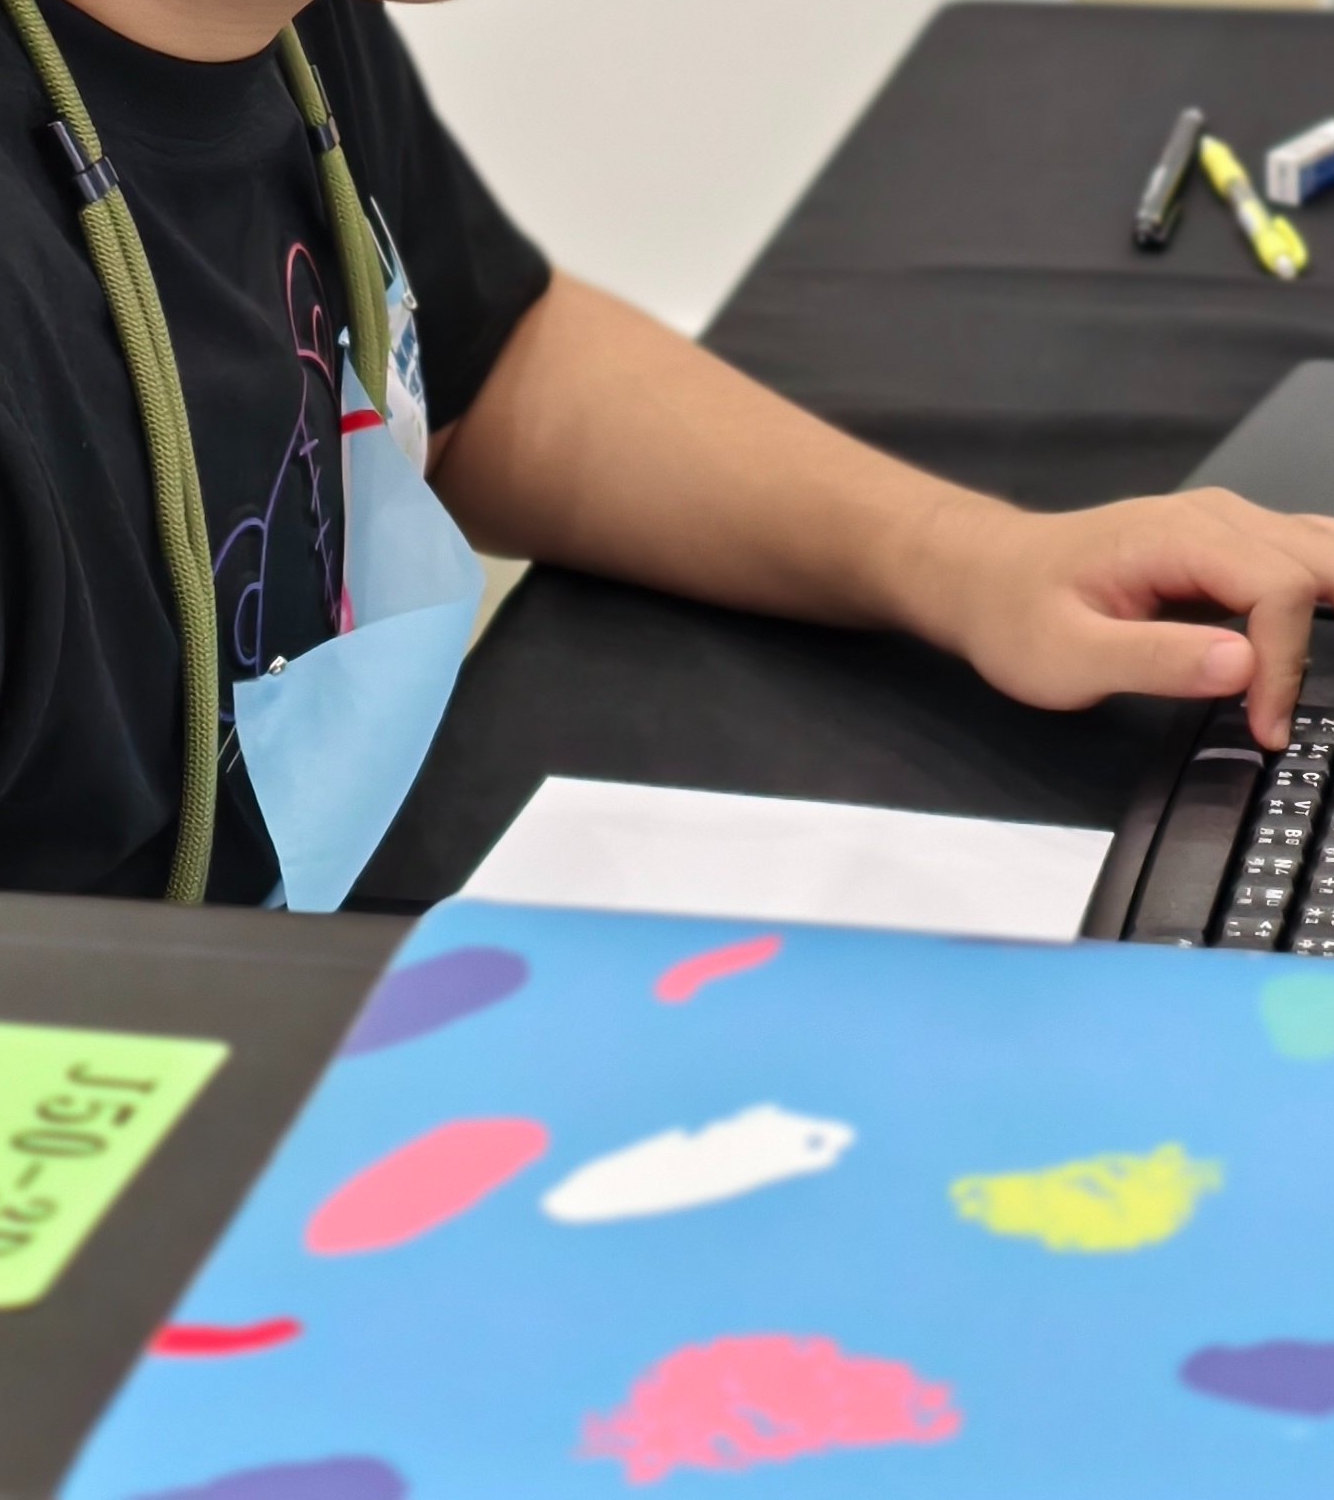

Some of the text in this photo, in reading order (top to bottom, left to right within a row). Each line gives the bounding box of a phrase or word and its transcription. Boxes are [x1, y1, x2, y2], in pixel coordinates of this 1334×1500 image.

[1312, 744, 1329, 752] X
[1303, 772, 1320, 781] C
[1294, 801, 1312, 809] V
[1285, 829, 1303, 838] B
[1274, 859, 1293, 869] N
[1265, 889, 1284, 899] M
